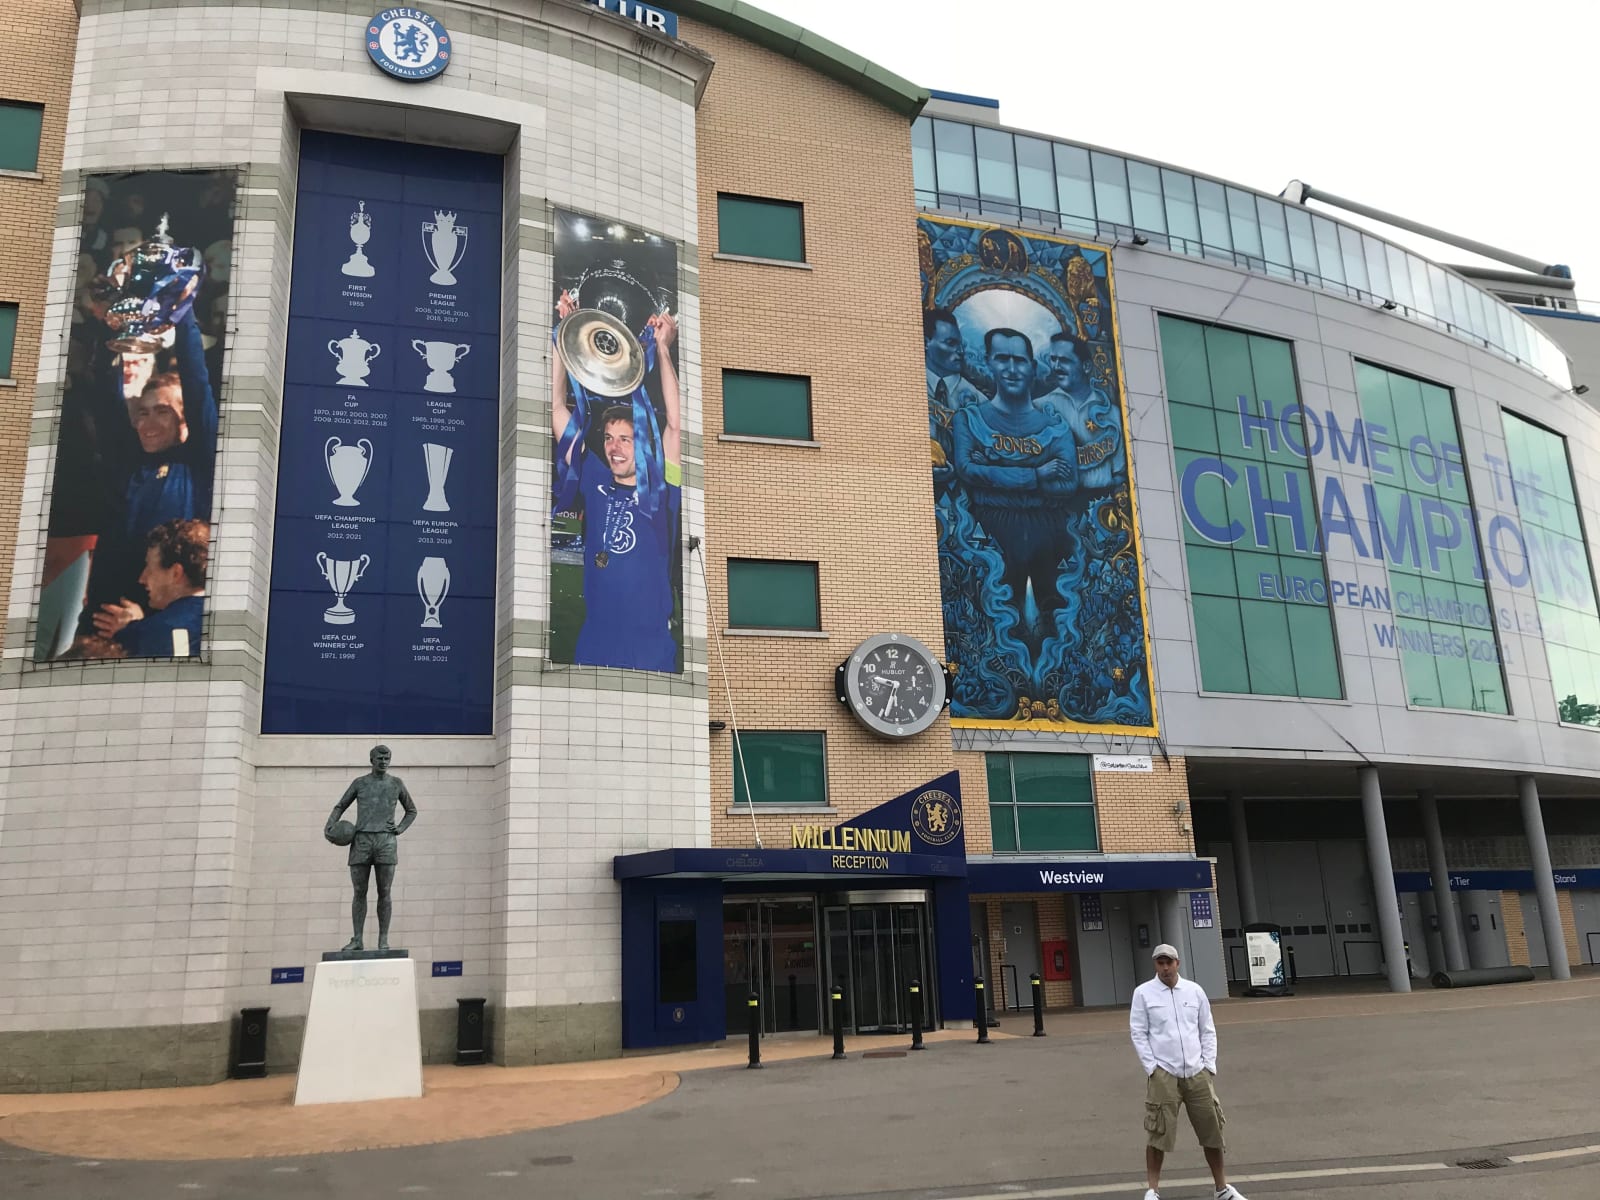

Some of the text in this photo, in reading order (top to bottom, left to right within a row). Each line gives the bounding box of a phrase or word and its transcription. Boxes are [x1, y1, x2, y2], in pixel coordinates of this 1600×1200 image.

[381, 8, 437, 29] CHELSEA
[380, 58, 437, 76] FOOTBALL CLUB
[341, 290, 372, 299] DIVISION
[428, 292, 457, 300] PREMIER
[426, 400, 452, 408] LEAGUE
[991, 434, 1042, 456] JONES
[1237, 394, 1549, 519] HOME OF THE
[334, 515, 376, 523] CHAMPIONS
[431, 520, 459, 528] EUROPA
[331, 522, 359, 530] LEAGUE
[422, 527, 449, 535] LEAGUE
[1180, 456, 1591, 609] CHAMPIONS
[1257, 572, 1392, 610] EUROPEAN
[1373, 622, 1514, 665] WINNERS 2021
[886, 649, 899, 659] 12
[863, 663, 924, 675] 10 2
[865, 695, 926, 706] 8 4
[918, 791, 951, 804] CHELSEA
[790, 824, 911, 853] MILLENNIUM
[832, 855, 889, 869] RECEPTION
[1039, 869, 1104, 884] Westview
[1454, 876, 1470, 886] Tier
[1554, 874, 1577, 883] Stand
